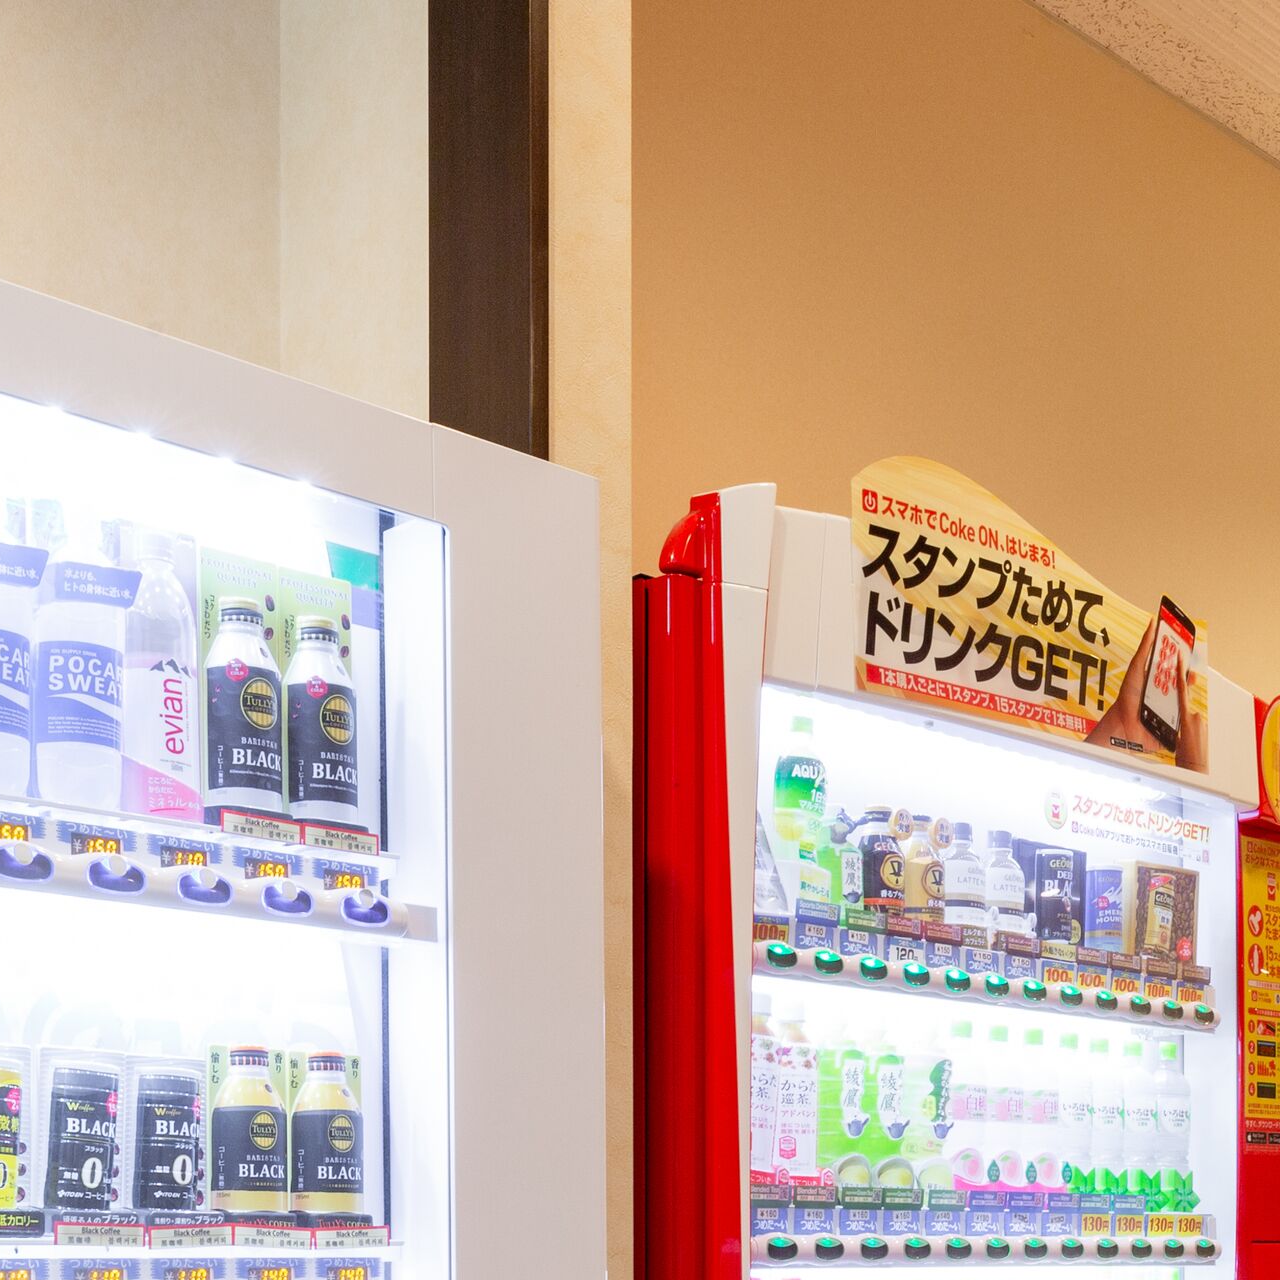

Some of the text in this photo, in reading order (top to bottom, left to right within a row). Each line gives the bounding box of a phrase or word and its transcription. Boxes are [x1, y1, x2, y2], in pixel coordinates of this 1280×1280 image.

[862, 524, 1111, 648] スタンプためて、
[865, 592, 1108, 712] ドリンクGET!
[878, 667, 1088, 734] 1本購入ごとに1スタンプ、15スタンプで1本無料!
[159, 676, 185, 756] evian
[232, 748, 281, 772] BLACK
[312, 762, 358, 786] BLACK
[245, 817, 280, 830] Black Coffee
[325, 831, 358, 842] Black Coffee
[238, 1163, 285, 1179] BLACK
[1082, 1215, 1109, 1232] 130円
[1116, 1215, 1142, 1232] 130円
[1149, 1216, 1174, 1233] 130円
